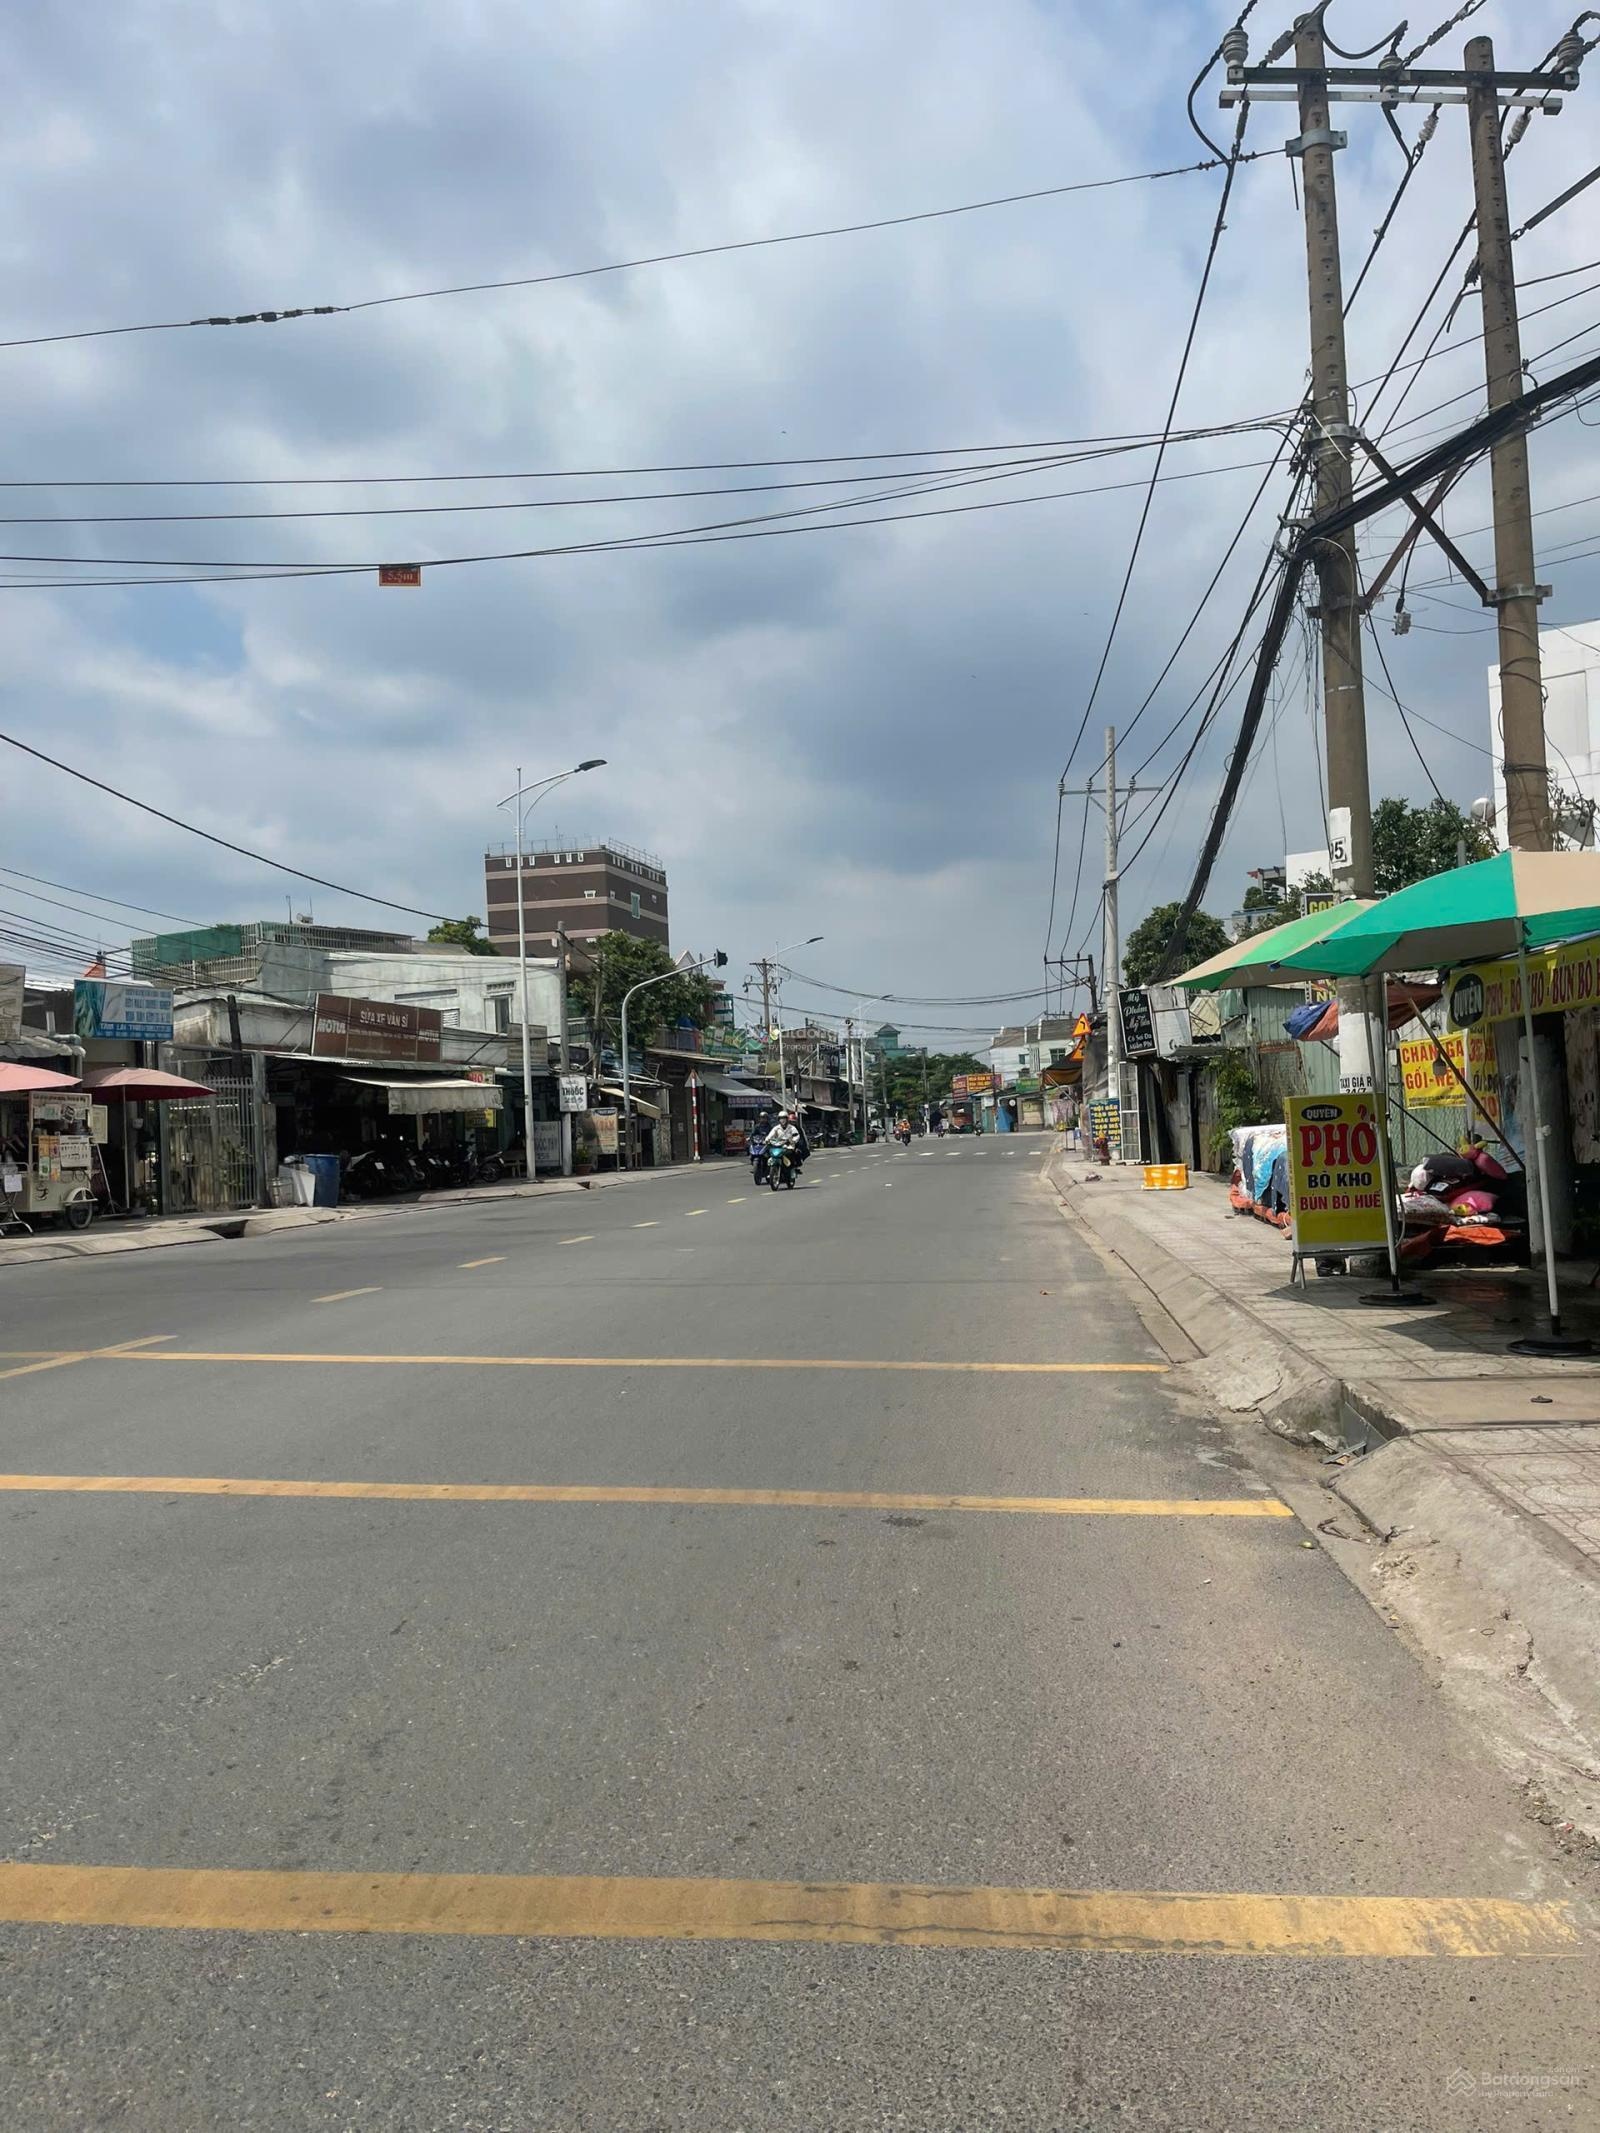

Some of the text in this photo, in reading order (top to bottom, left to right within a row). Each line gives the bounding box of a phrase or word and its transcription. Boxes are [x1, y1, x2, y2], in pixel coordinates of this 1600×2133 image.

[317, 1018, 346, 1035] MOTUL
[1308, 1171, 1373, 1189] BÒ KHO
[1300, 1193, 1328, 1211] BÚN
[1332, 1191, 1350, 1209] BÒ
